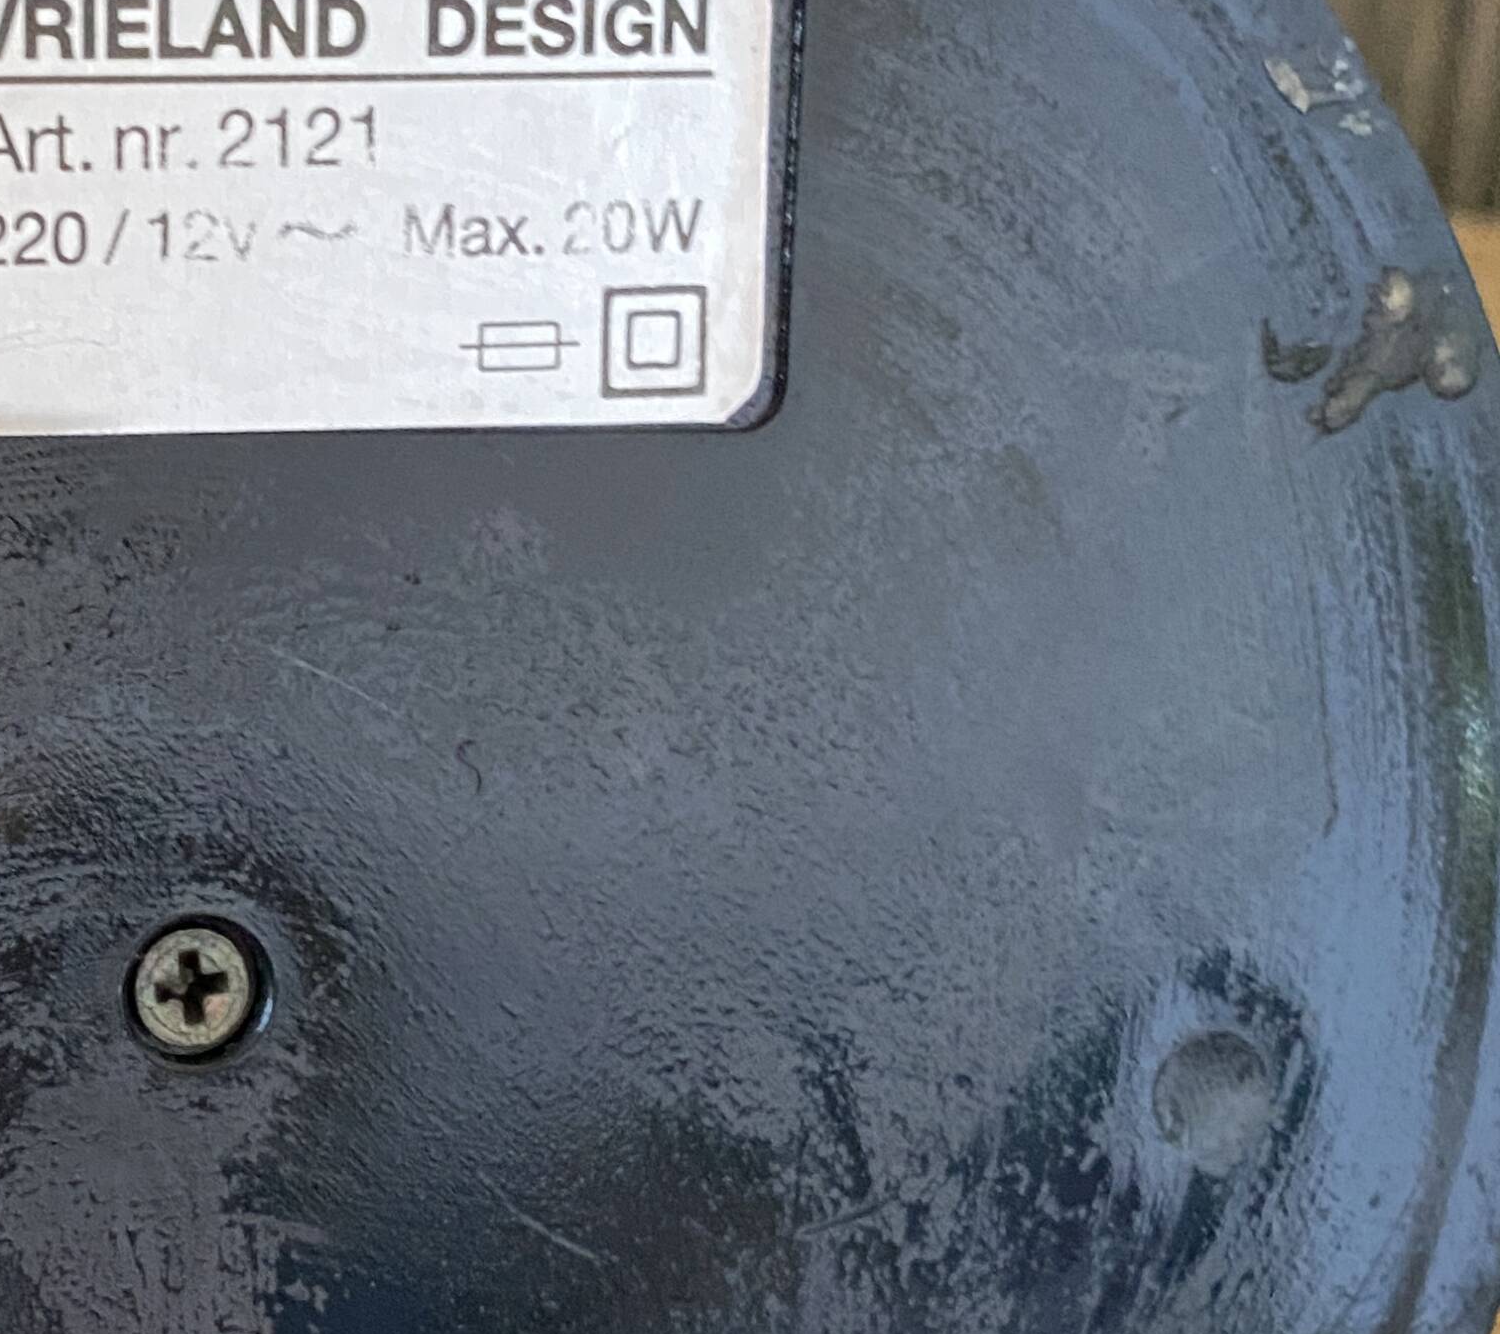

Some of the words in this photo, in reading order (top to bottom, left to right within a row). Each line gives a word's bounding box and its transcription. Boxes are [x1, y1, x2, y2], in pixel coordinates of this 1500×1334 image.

[115, 124, 200, 171] nr.
[217, 105, 378, 168] 2121
[403, 202, 547, 258] Max.
